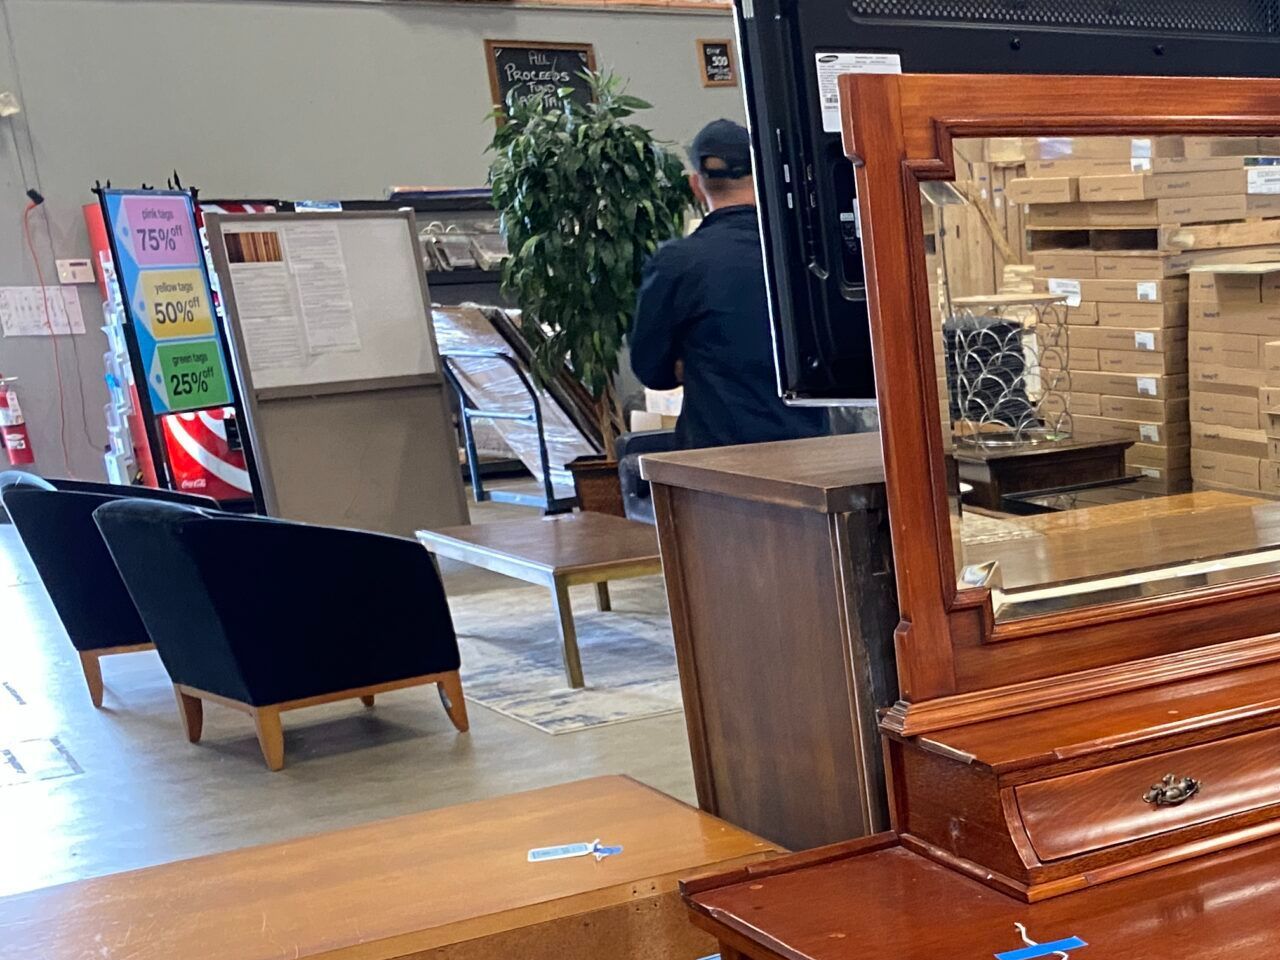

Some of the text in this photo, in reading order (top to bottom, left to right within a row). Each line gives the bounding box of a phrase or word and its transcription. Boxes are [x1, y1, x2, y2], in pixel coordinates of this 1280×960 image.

[141, 208, 174, 220] pink tags
[136, 224, 183, 252] 75% off
[154, 282, 193, 295] yellow tags
[154, 297, 200, 325] 50% off
[172, 352, 209, 367] green tags
[170, 367, 215, 396] 25% off
